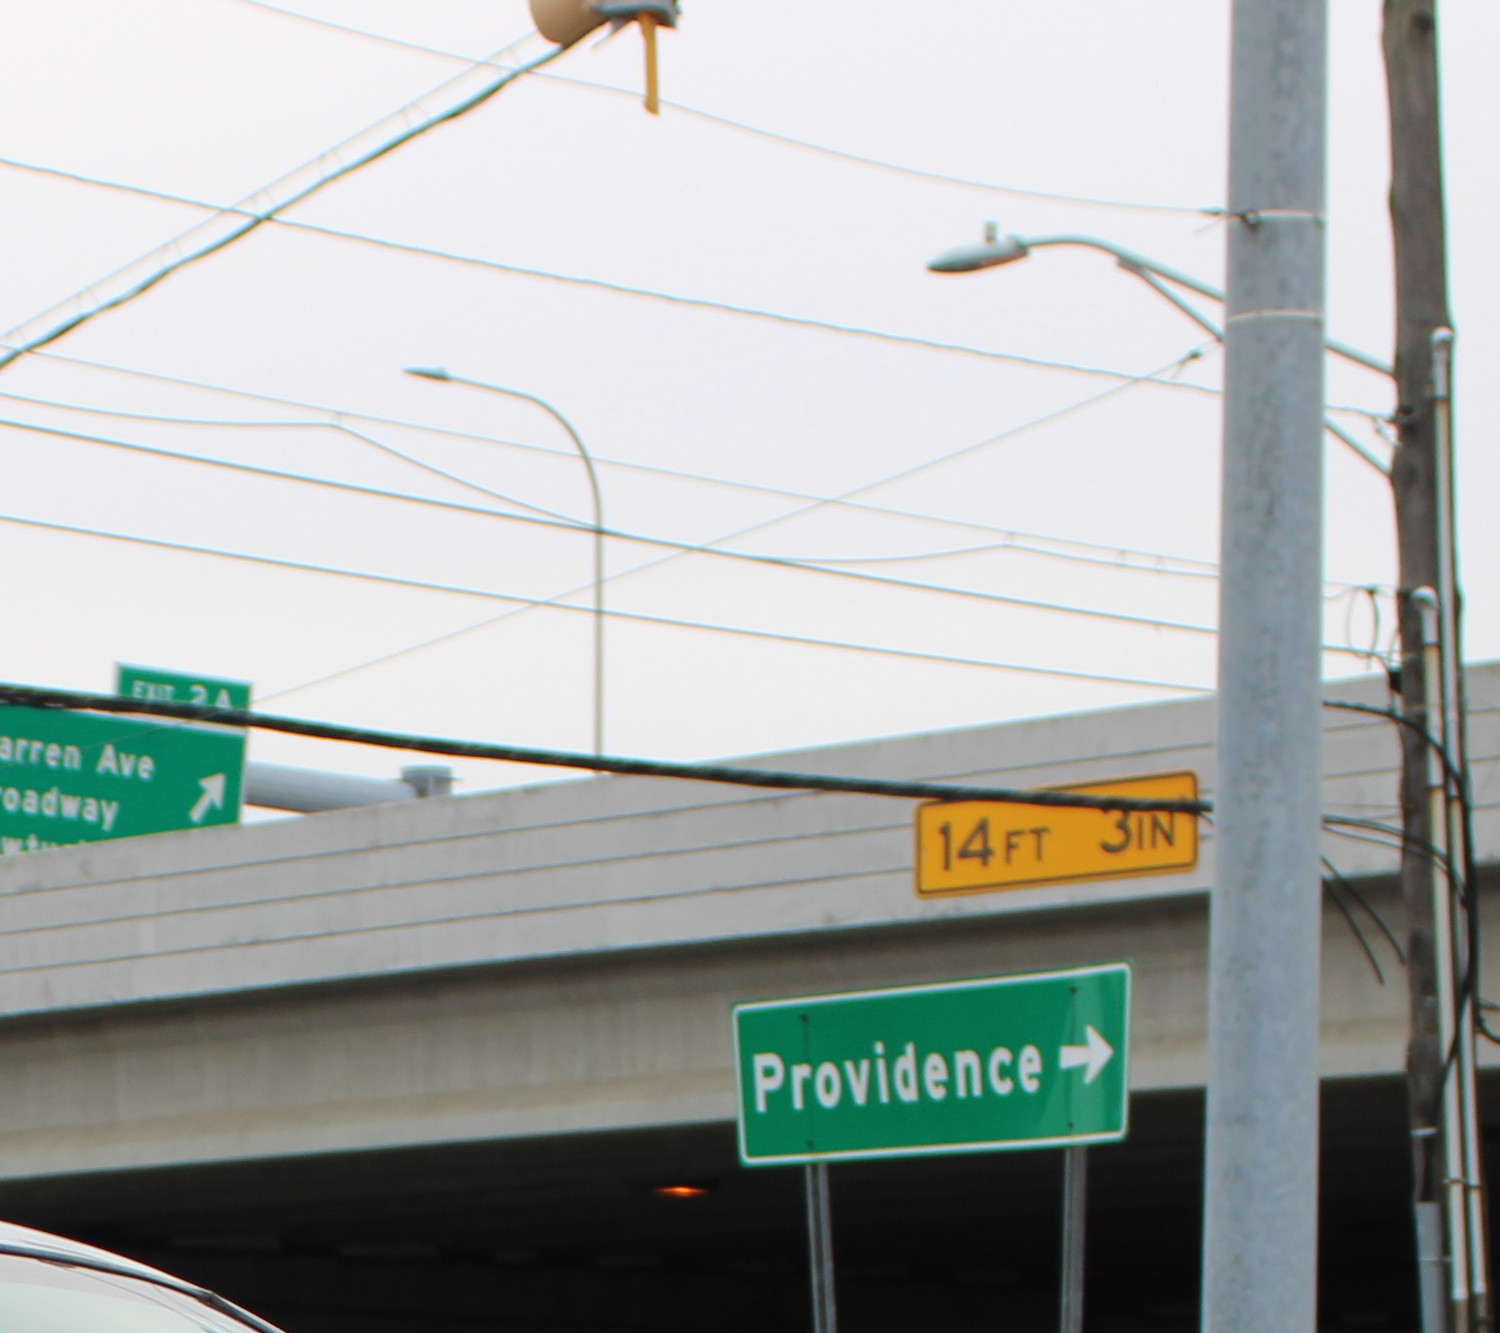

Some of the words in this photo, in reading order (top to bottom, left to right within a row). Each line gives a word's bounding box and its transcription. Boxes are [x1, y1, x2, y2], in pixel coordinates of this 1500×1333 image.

[133, 680, 175, 702] EXIT
[97, 743, 156, 781] Ave
[753, 1041, 1043, 1113] Providence
